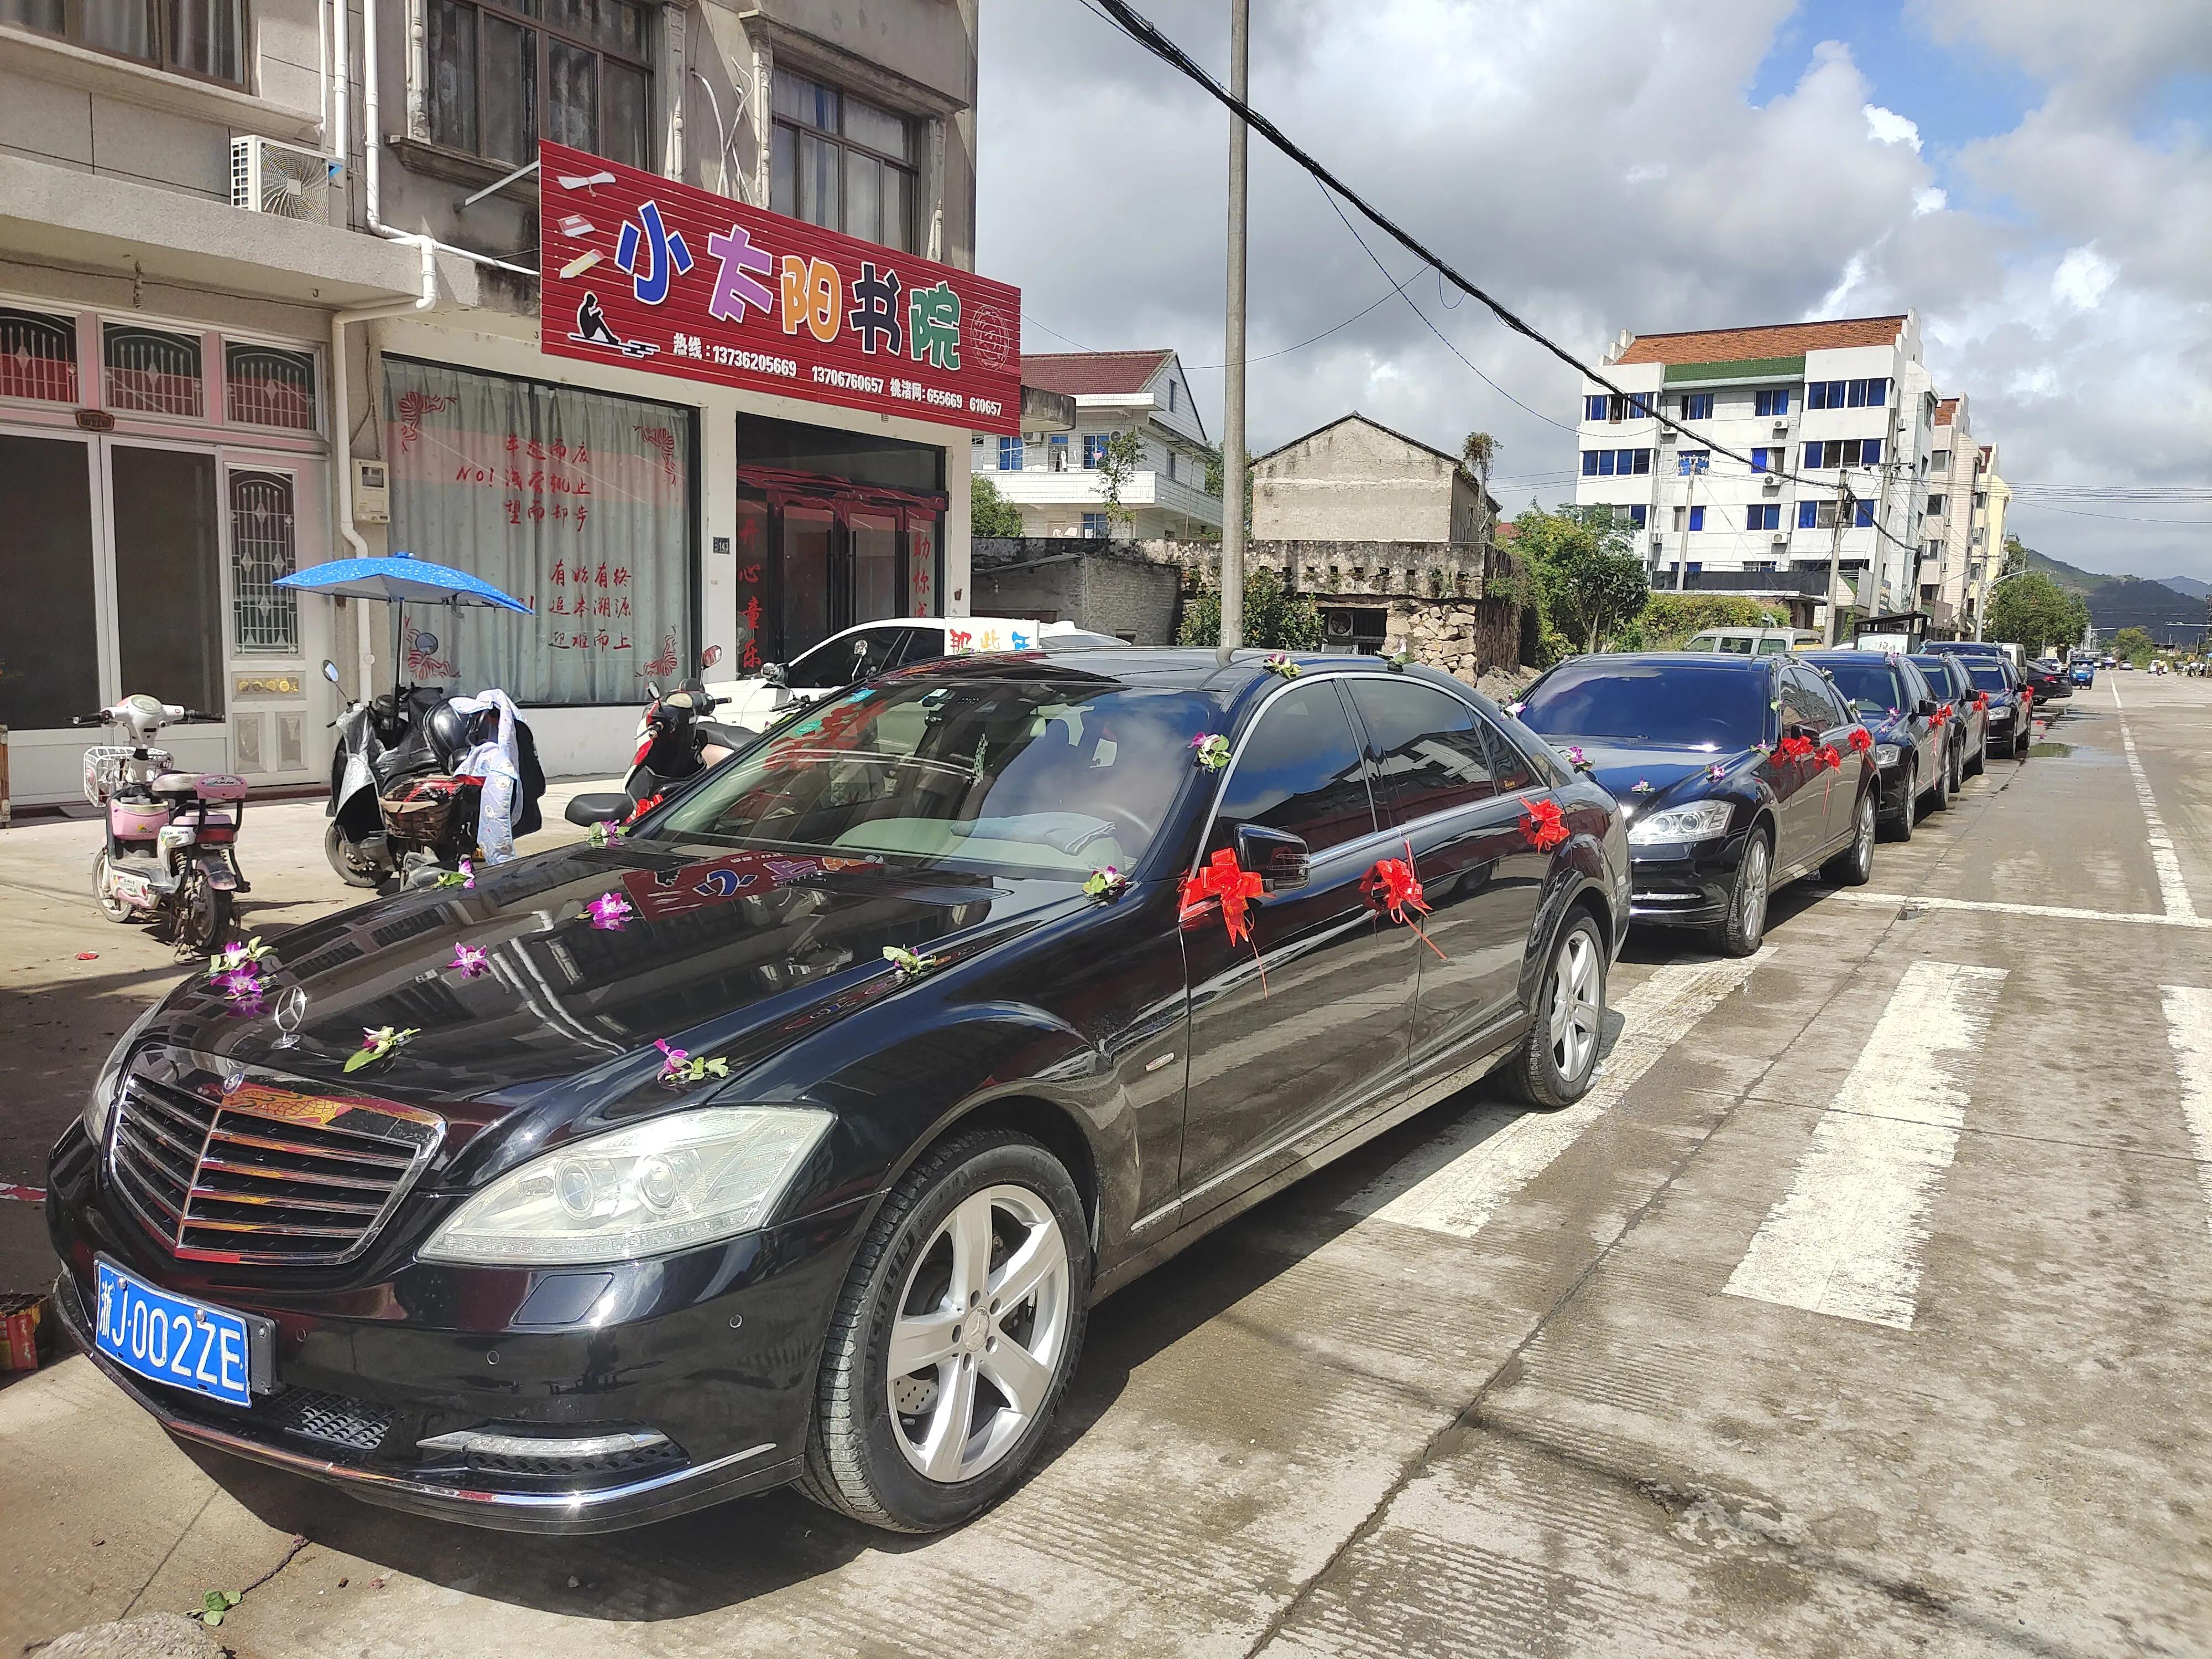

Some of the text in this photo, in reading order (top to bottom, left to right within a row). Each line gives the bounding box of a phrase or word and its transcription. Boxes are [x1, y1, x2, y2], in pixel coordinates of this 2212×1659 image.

[614, 200, 961, 371] 小太阳书院
[812, 366, 884, 393] 13706760657
[969, 397, 1002, 416] 610657
